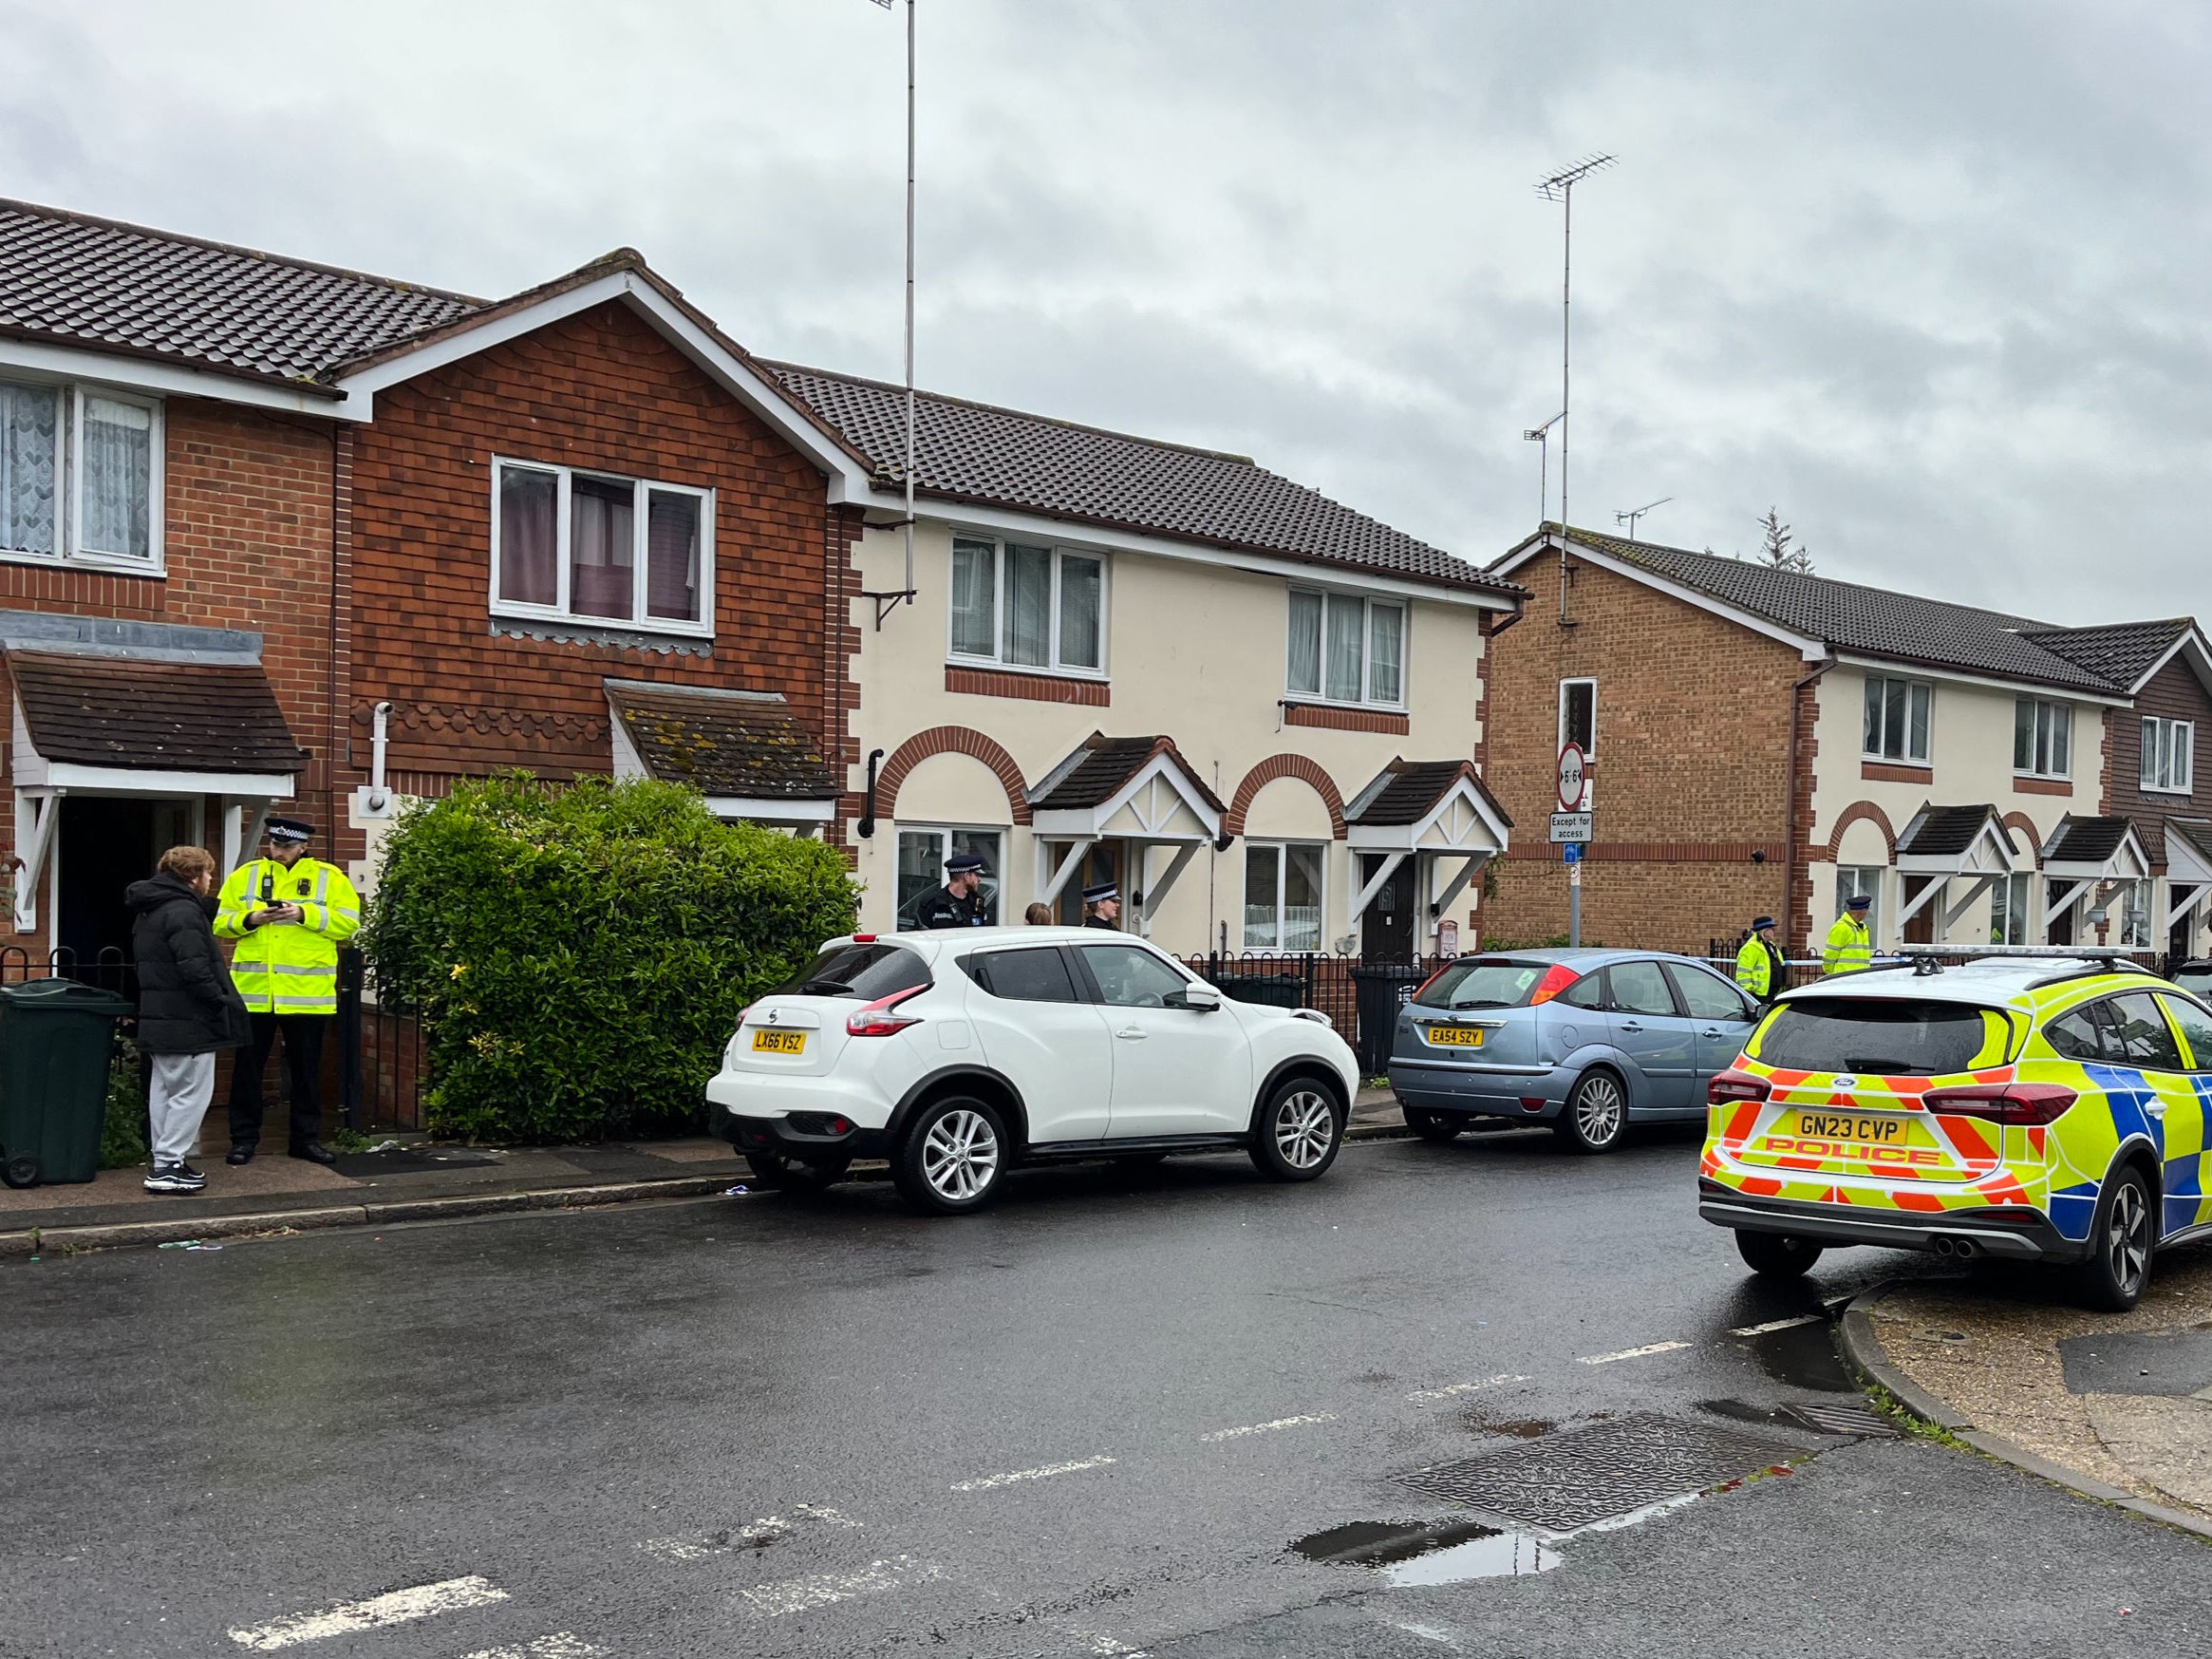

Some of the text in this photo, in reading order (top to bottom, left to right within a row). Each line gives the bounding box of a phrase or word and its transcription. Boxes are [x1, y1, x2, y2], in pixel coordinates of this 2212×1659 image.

[1552, 817, 1590, 827] Except for
[756, 1031, 801, 1050] LX66 VSZ
[1433, 1029, 1478, 1044] EA54 SZY
[1801, 1115, 1898, 1141] GN23 CVP
[1765, 1138, 1940, 1166] POLICE
